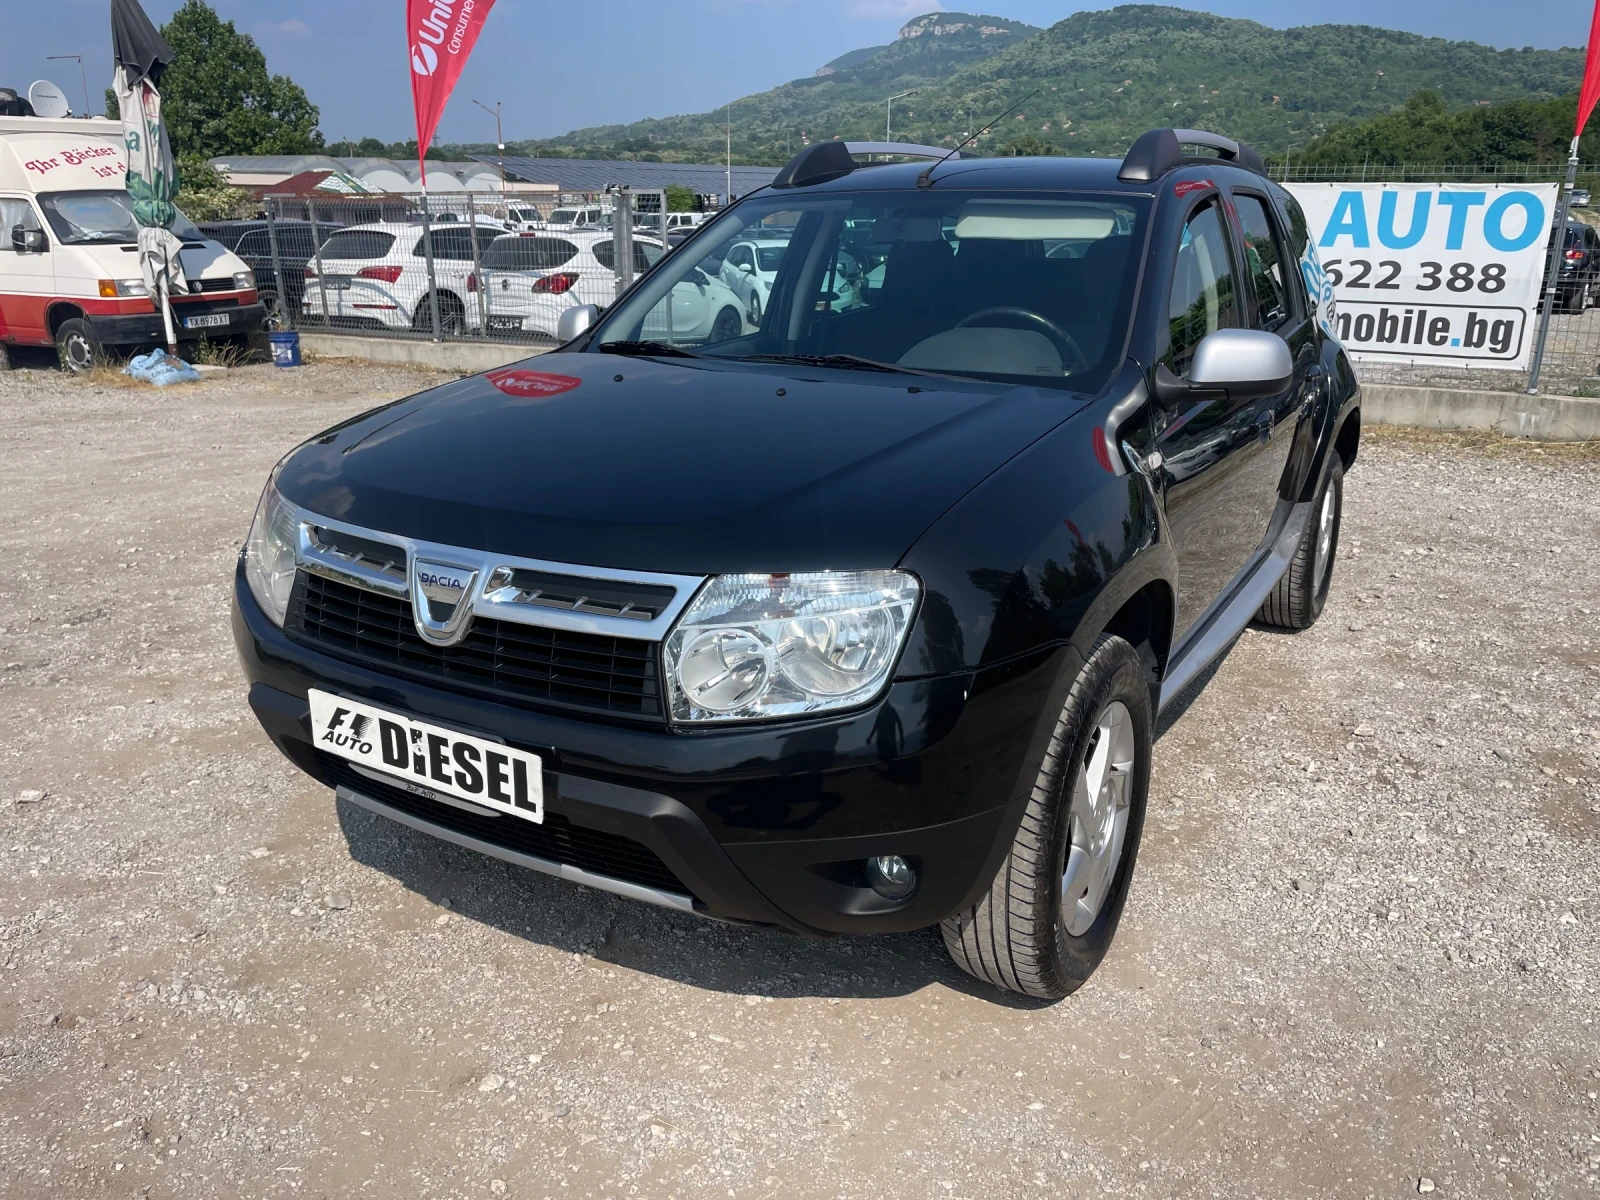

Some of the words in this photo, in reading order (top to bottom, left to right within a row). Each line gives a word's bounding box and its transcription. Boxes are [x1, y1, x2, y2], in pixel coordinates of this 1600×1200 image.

[25, 157, 60, 175] Ihr
[60, 146, 117, 166] Bäcker
[91, 165, 118, 178] ist
[1318, 190, 1545, 253] AUTO
[1415, 261, 1507, 293] 388
[421, 572, 461, 590] DACIA
[321, 730, 373, 755] AUTO
